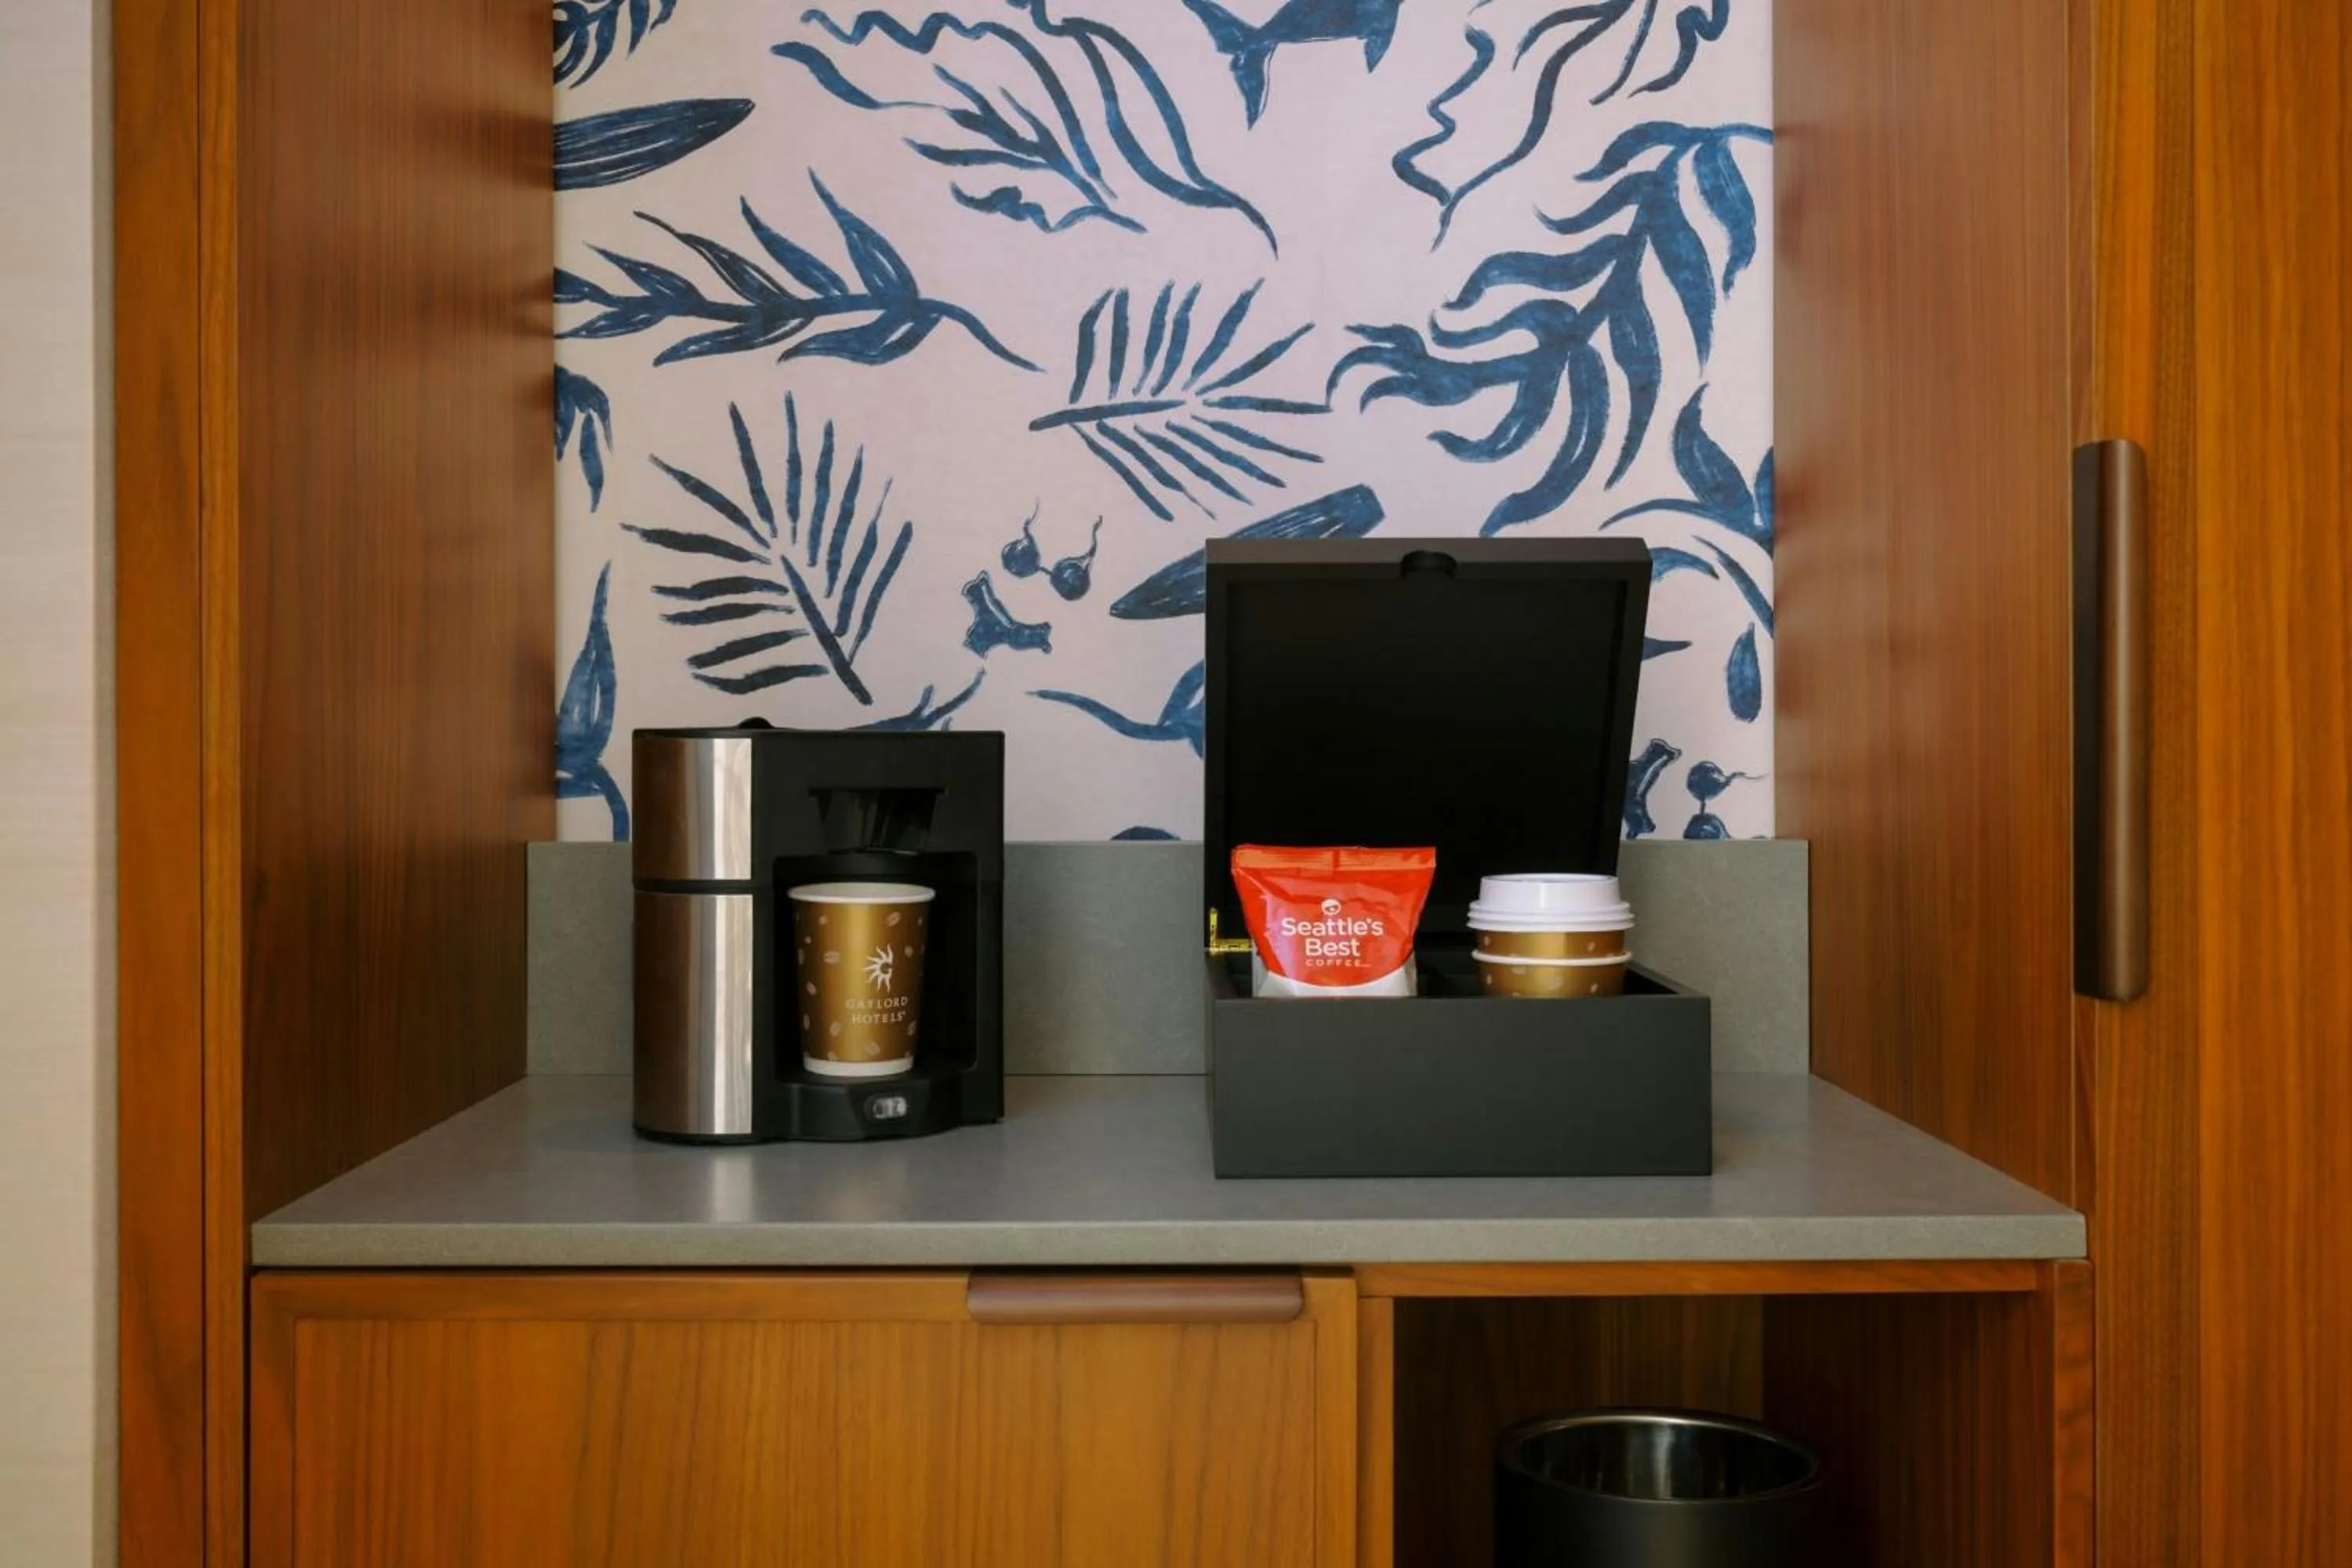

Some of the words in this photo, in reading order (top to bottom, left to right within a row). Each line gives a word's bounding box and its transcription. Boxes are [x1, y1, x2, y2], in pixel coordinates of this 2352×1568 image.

[1281, 916, 1384, 936] Seattle's
[1305, 938, 1360, 956] Best
[845, 996, 909, 1010] GAYLORD
[852, 1011, 906, 1024] HOTELS
